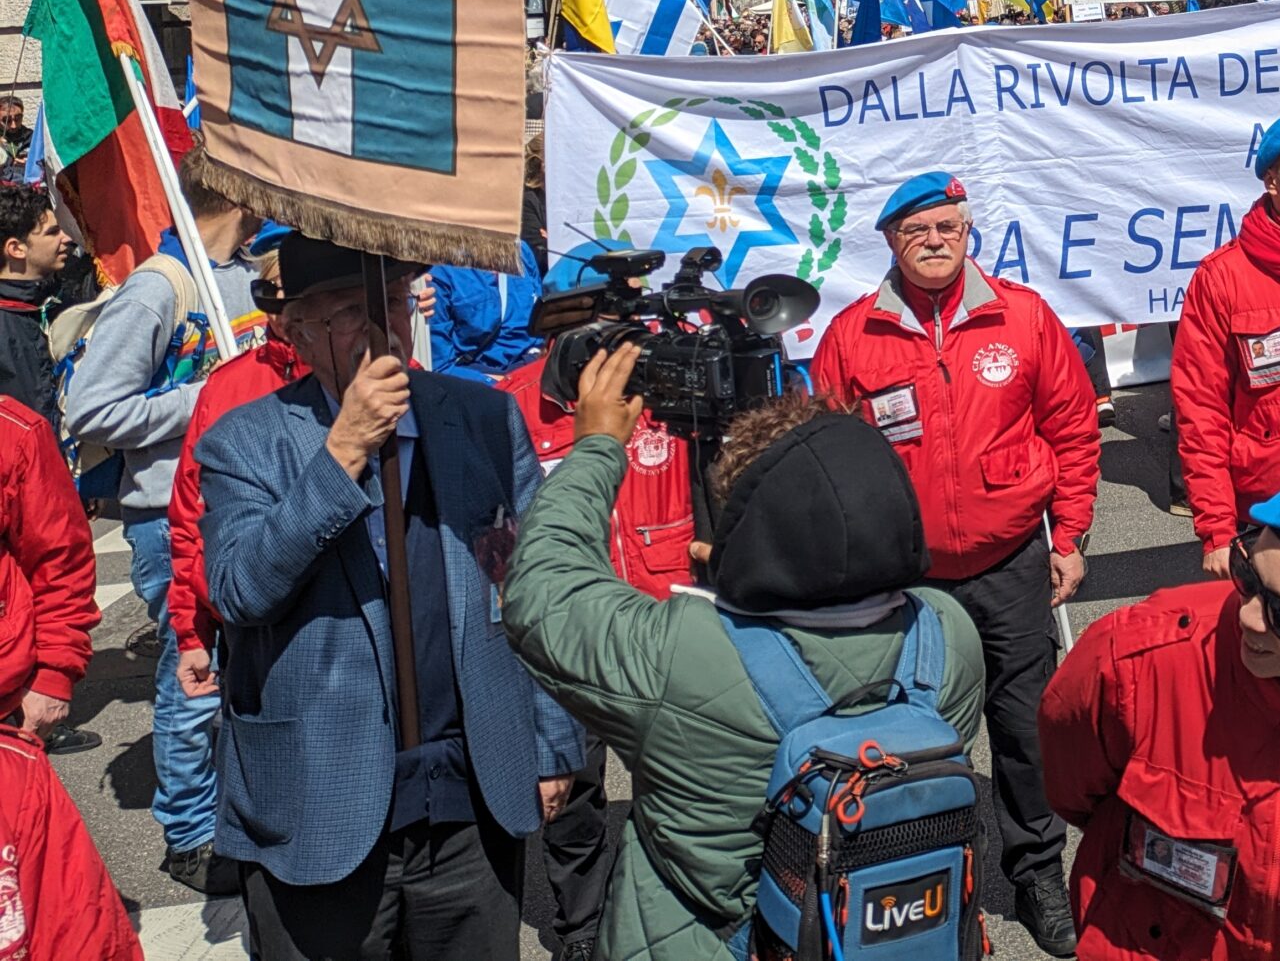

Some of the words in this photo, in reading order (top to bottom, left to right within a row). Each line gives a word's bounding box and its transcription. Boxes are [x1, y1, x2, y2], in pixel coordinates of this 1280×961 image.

[819, 68, 977, 127] DALLA
[994, 56, 1199, 112] RIVOLTA
[1059, 213, 1098, 280] E
[972, 347, 985, 372] CITY
[988, 342, 1020, 367] ANGELS
